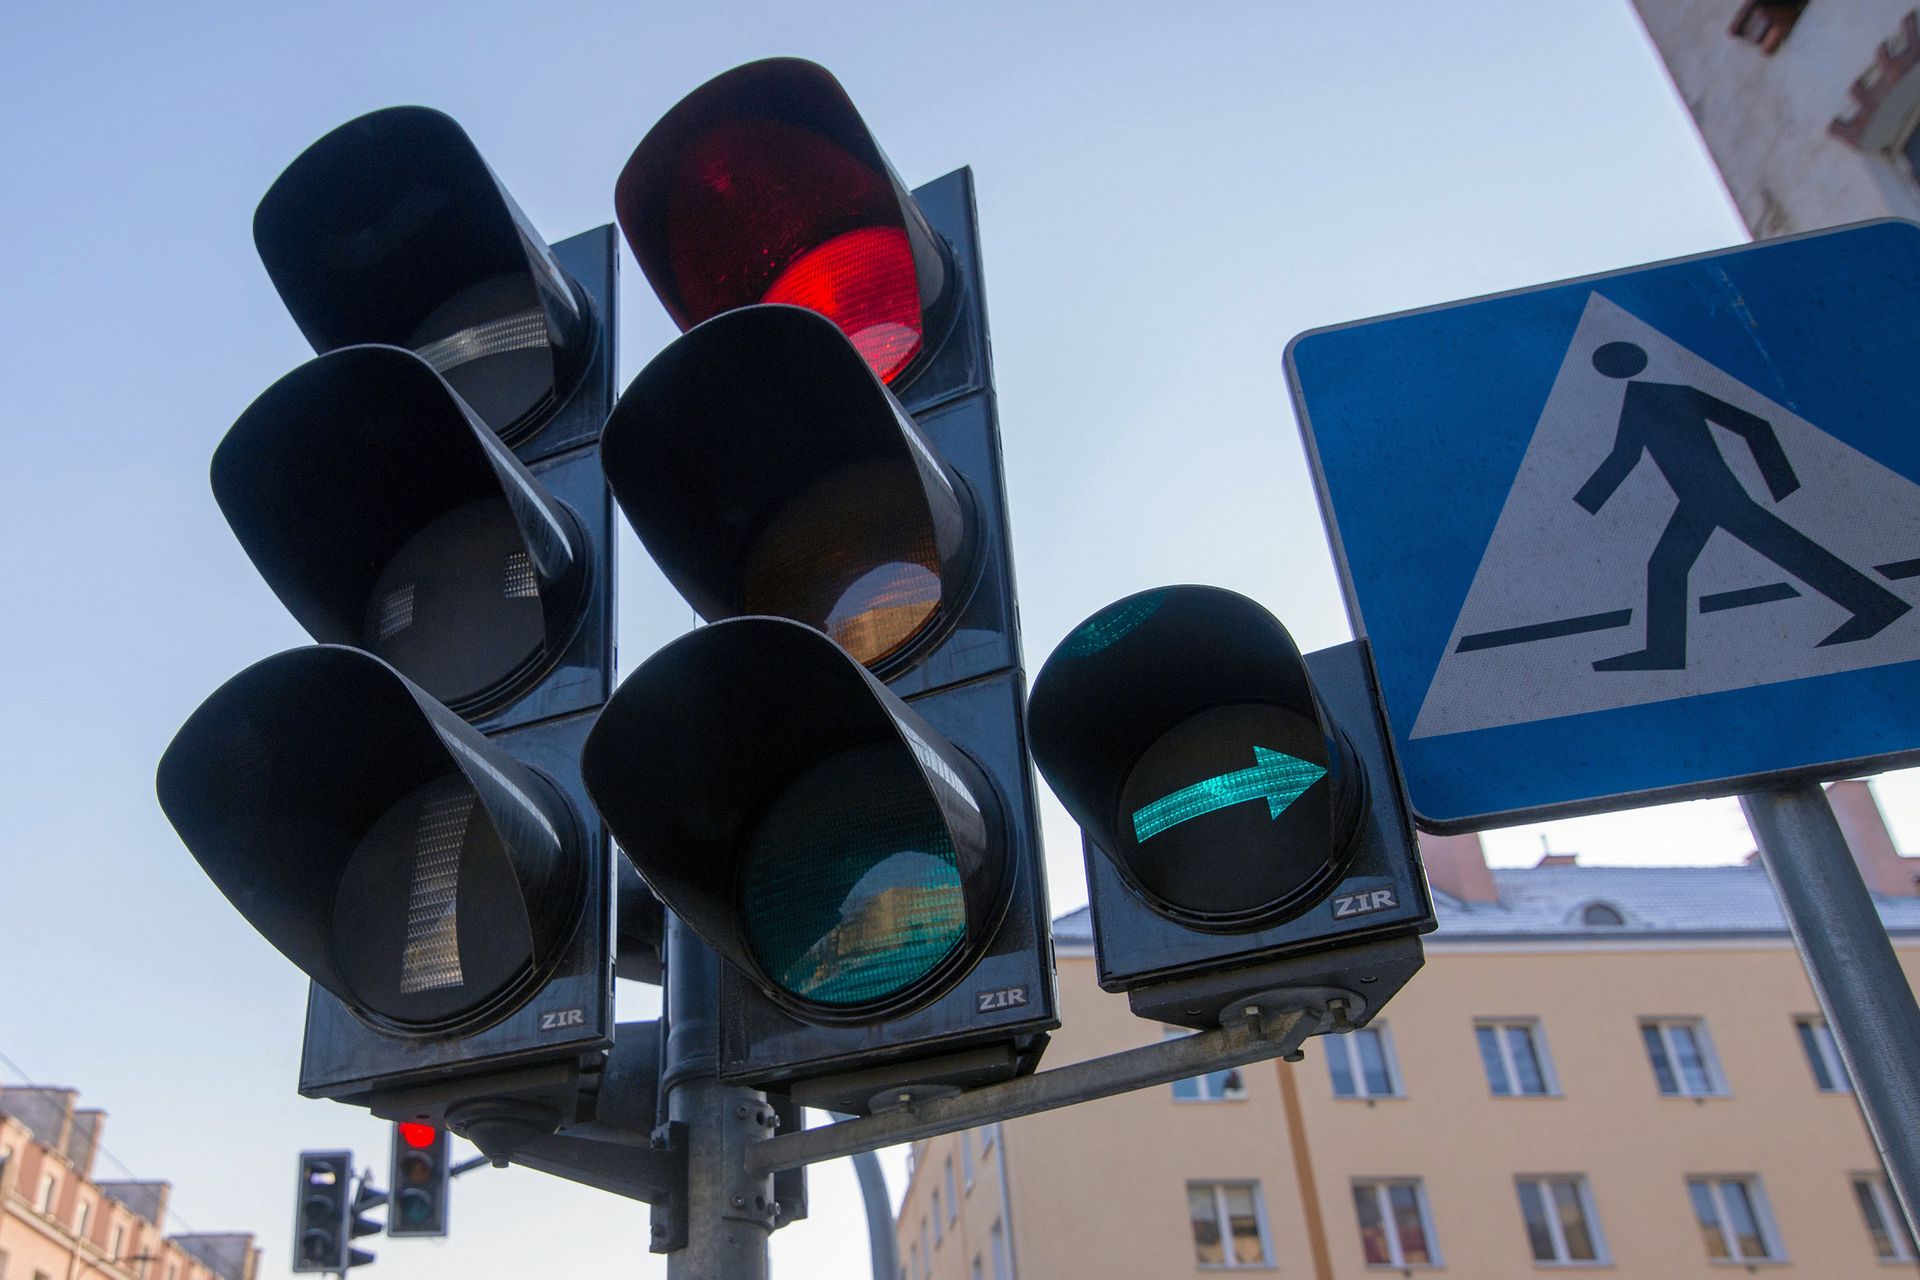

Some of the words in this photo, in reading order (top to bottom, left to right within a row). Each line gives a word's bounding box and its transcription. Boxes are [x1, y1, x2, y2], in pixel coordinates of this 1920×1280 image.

[1335, 890, 1396, 916] ZIR
[980, 988, 1026, 1011] ZIR
[542, 1009, 584, 1030] ZIR
